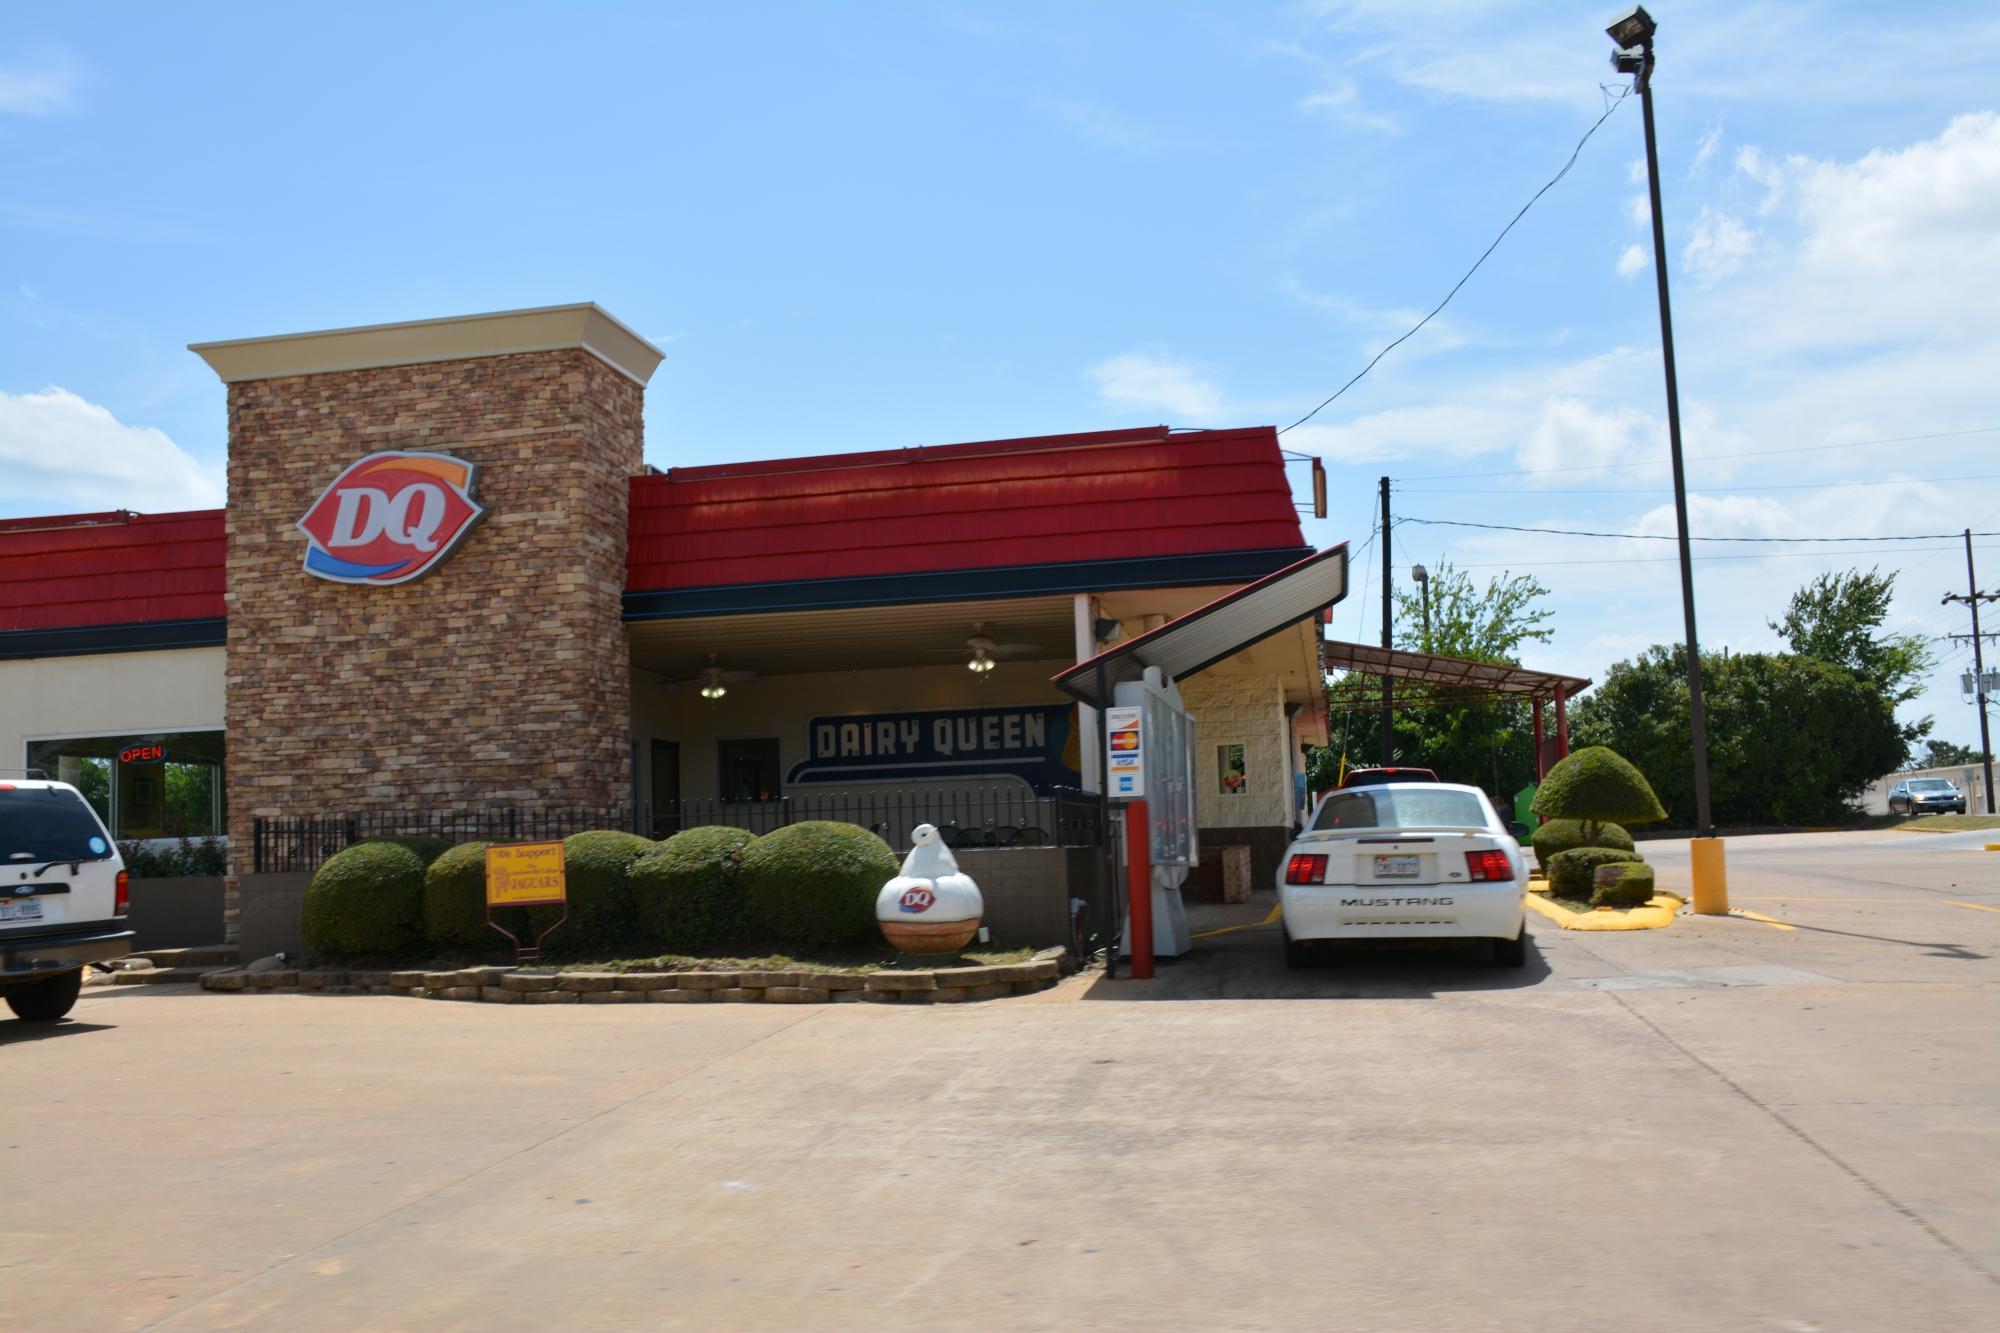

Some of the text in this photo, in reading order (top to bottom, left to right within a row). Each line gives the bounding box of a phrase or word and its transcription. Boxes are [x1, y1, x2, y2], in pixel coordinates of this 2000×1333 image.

[328, 482, 446, 552] DQ
[816, 713, 1045, 758] DAIRY QUEEN
[121, 746, 162, 763] OPEN
[515, 847, 556, 859] Support
[511, 876, 560, 890] JAGUARS
[904, 892, 930, 906] DQ
[1340, 897, 1454, 907] MUSTANG
